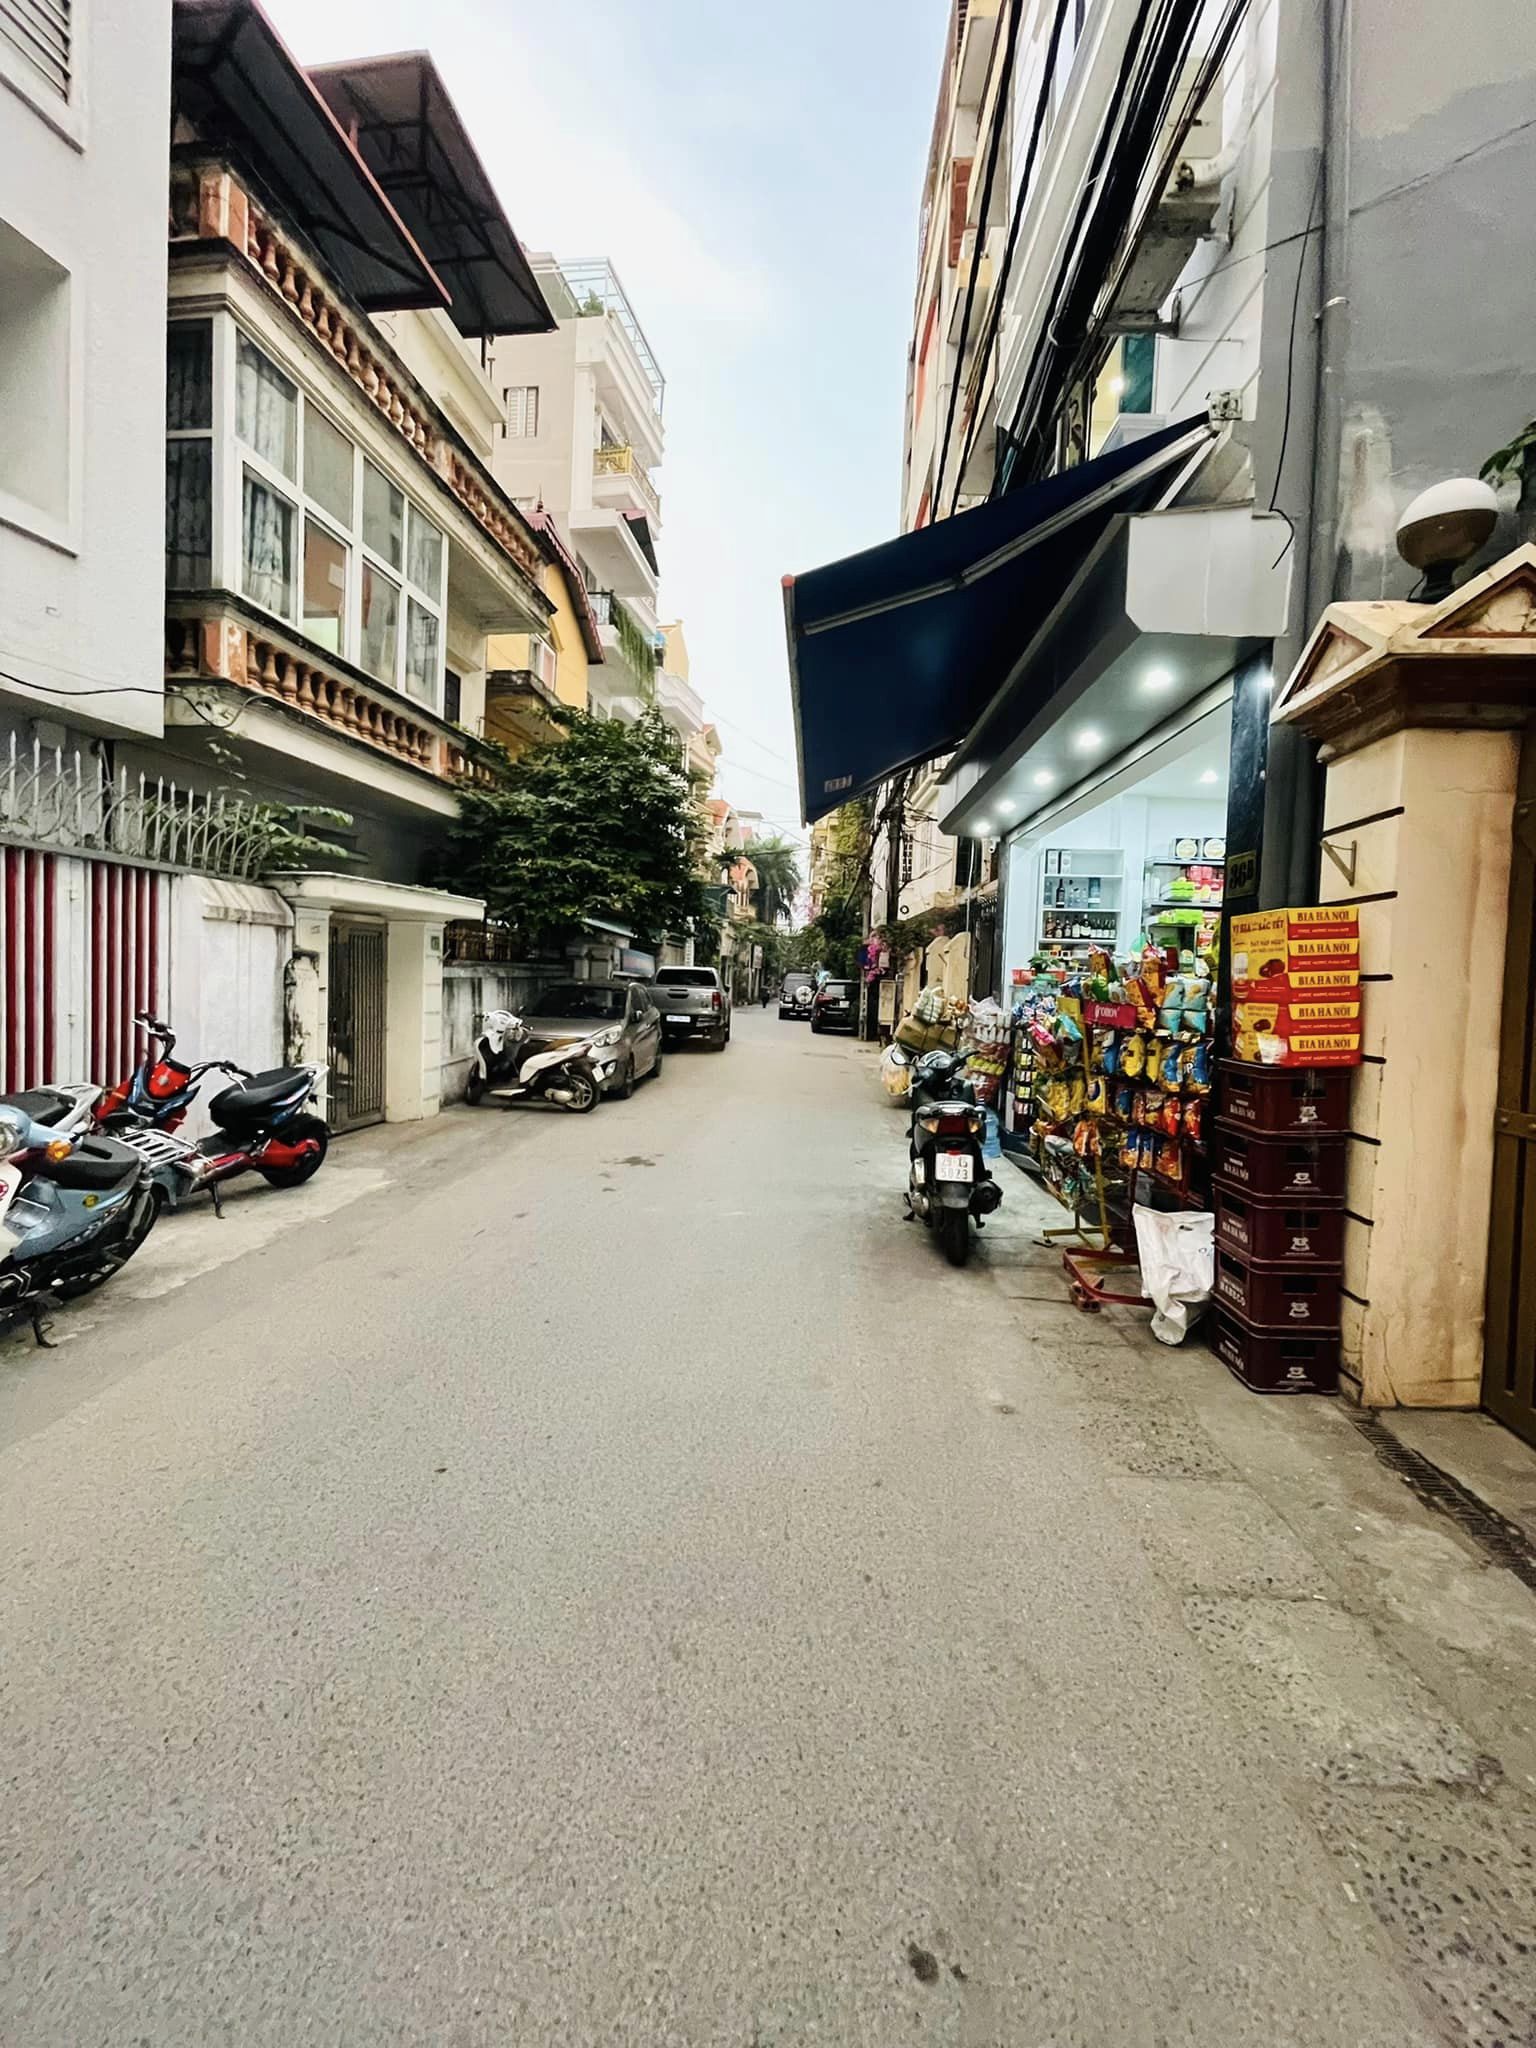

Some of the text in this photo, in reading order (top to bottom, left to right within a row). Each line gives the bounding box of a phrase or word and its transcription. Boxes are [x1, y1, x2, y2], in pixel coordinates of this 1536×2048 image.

[1297, 912, 1314, 921] BIA
[1298, 943, 1315, 953] BIA
[1298, 976, 1316, 986] BIA
[1299, 1008, 1316, 1017] BIA
[1299, 1040, 1316, 1049] BIA
